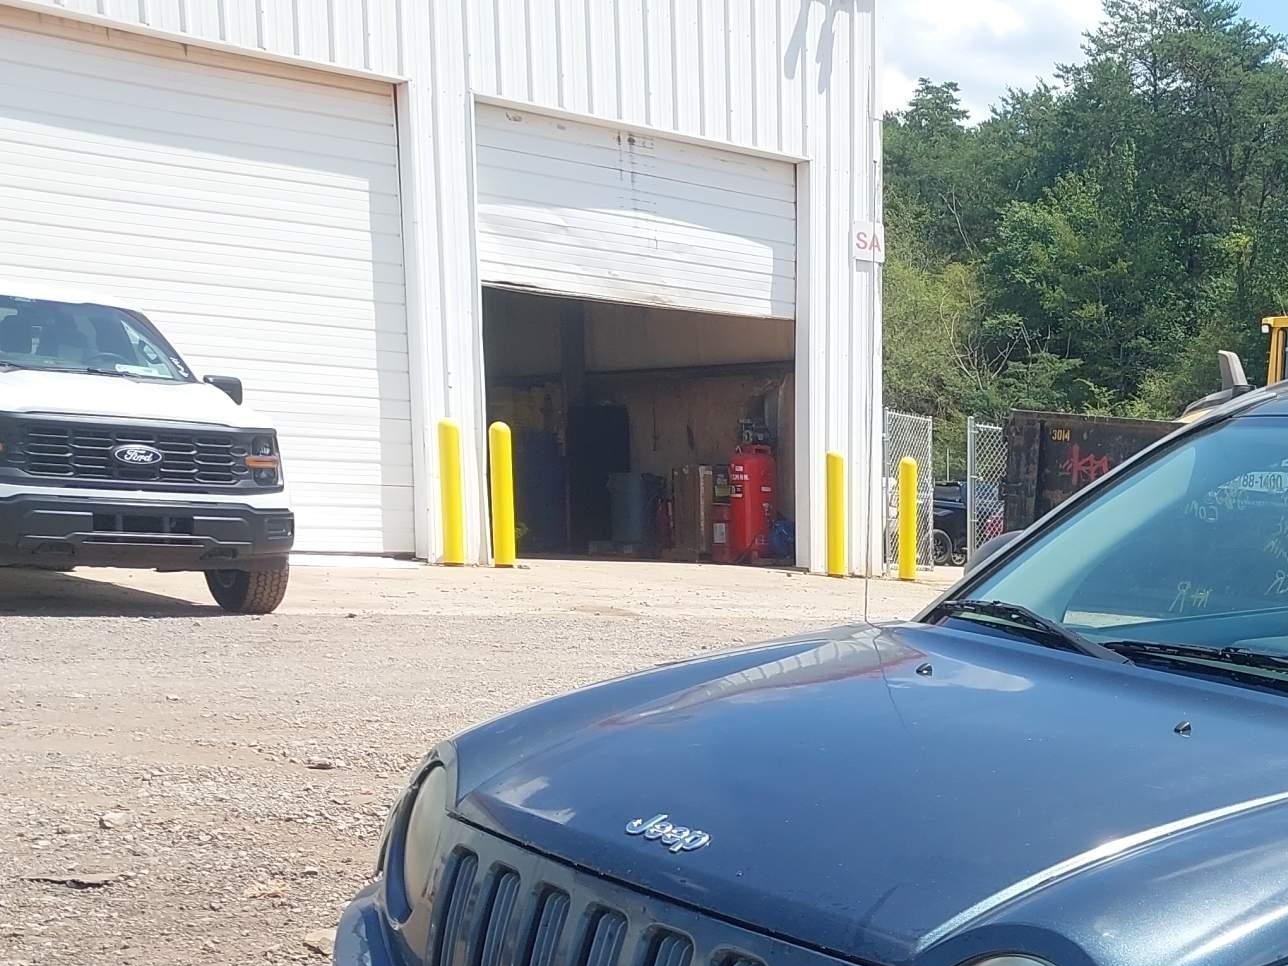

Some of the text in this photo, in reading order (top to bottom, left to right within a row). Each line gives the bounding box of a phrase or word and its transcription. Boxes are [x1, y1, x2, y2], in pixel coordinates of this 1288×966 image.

[855, 231, 882, 253] SA
[123, 448, 154, 463] Ford
[626, 813, 711, 853] Jeep
